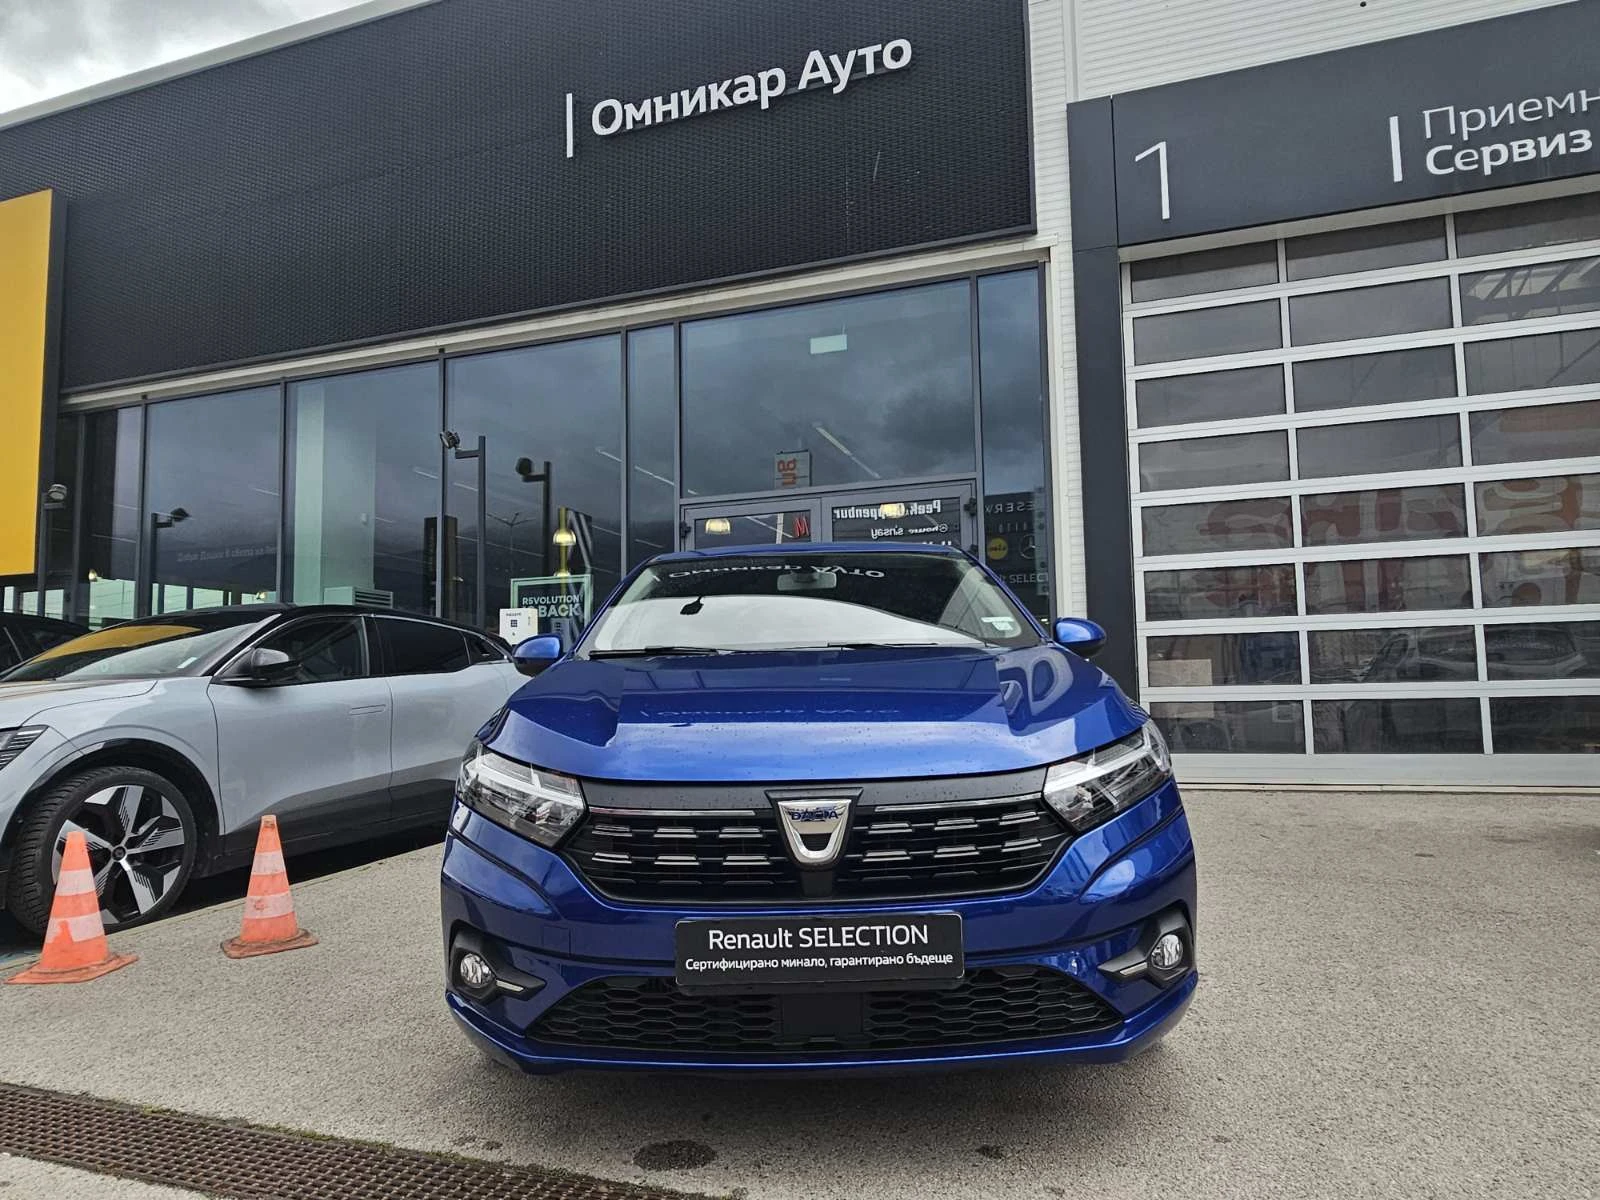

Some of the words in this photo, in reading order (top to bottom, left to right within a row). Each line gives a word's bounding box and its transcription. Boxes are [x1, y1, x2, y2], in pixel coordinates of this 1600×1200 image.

[591, 67, 786, 135] Омникар
[798, 38, 912, 95] Ауто
[1426, 129, 1593, 176] Сервиз
[1134, 141, 1170, 220] 1
[538, 603, 582, 618] BACK
[708, 927, 793, 950] Renault
[798, 924, 929, 948] SELECTION
[685, 956, 779, 971] Сертифицирано
[780, 956, 828, 969] минало,
[829, 954, 905, 968] гарантирано
[906, 951, 953, 966] бъдеще
